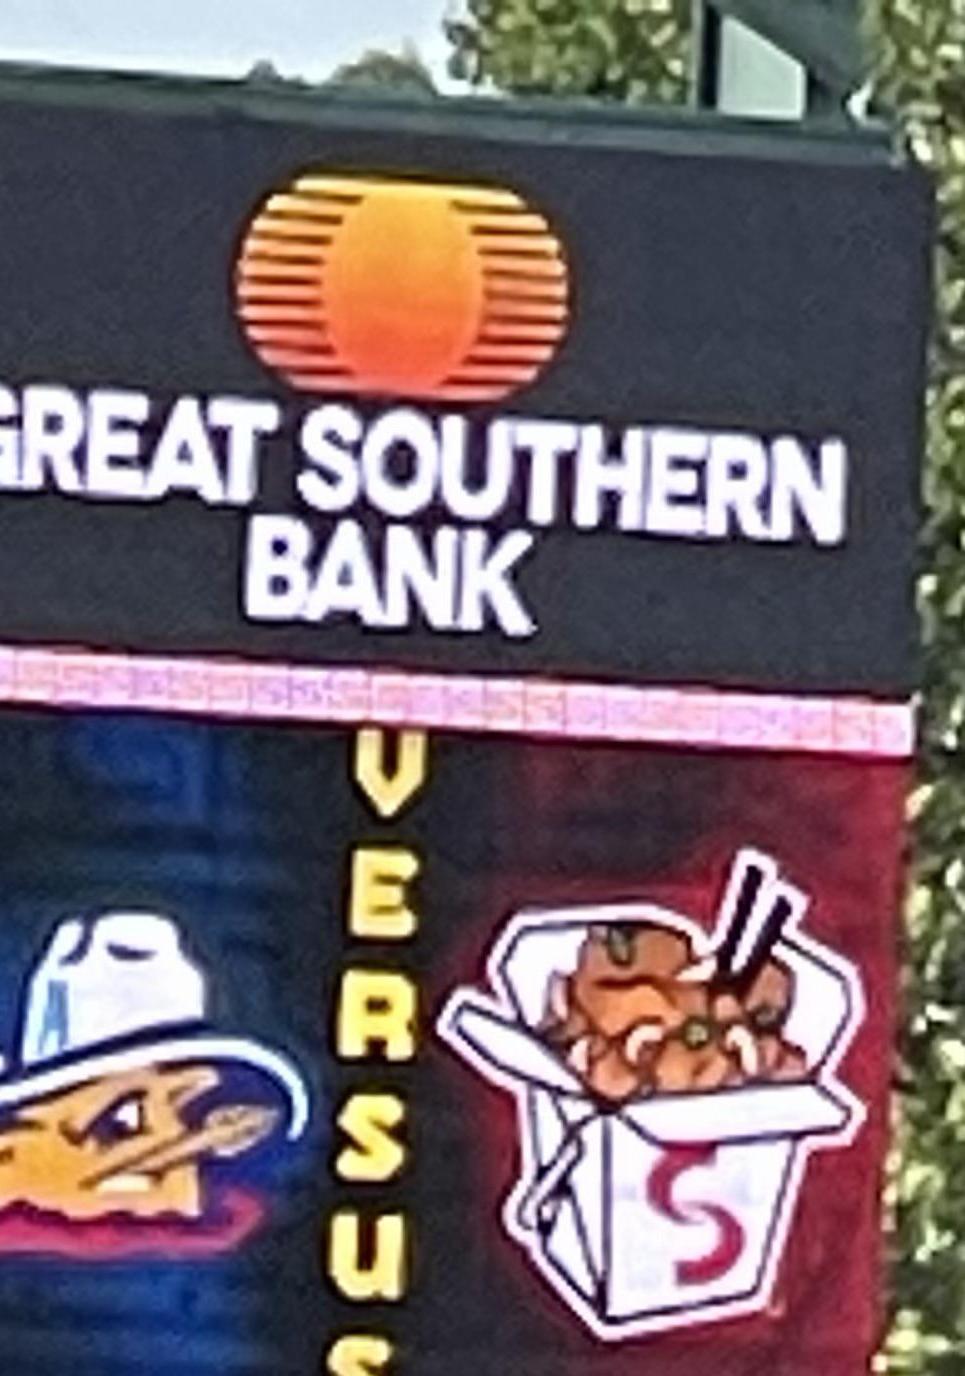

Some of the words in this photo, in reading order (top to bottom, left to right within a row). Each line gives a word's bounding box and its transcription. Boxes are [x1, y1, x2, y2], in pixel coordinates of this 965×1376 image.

[296, 410, 847, 543] SOUTHERN
[246, 514, 537, 639] BANK
[644, 1143, 746, 1287] S
